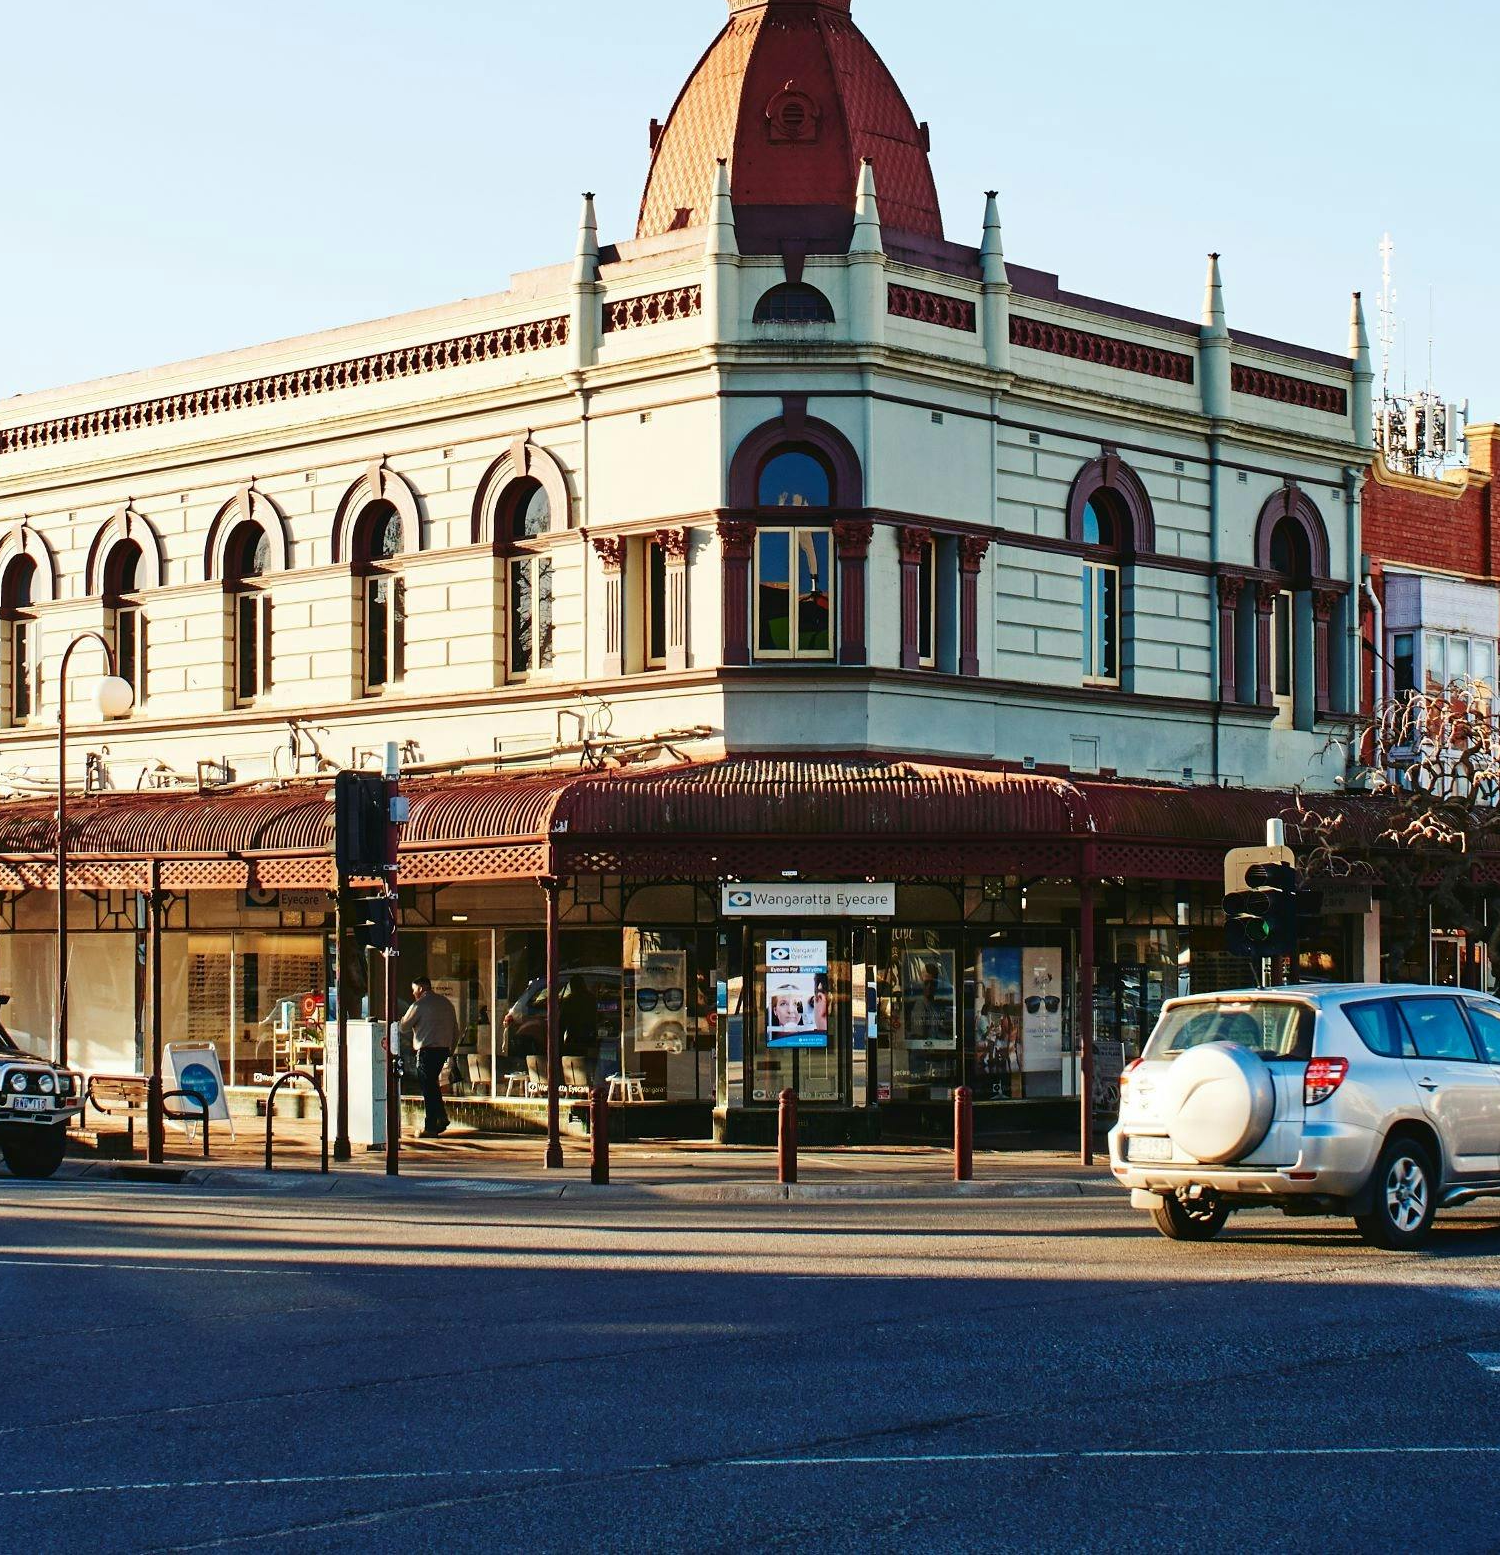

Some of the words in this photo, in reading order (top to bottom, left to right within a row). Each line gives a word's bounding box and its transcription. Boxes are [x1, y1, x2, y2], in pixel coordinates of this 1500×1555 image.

[281, 894, 319, 906] Eyecare
[754, 893, 831, 908] Wangaratta
[837, 893, 888, 908] Eyecare
